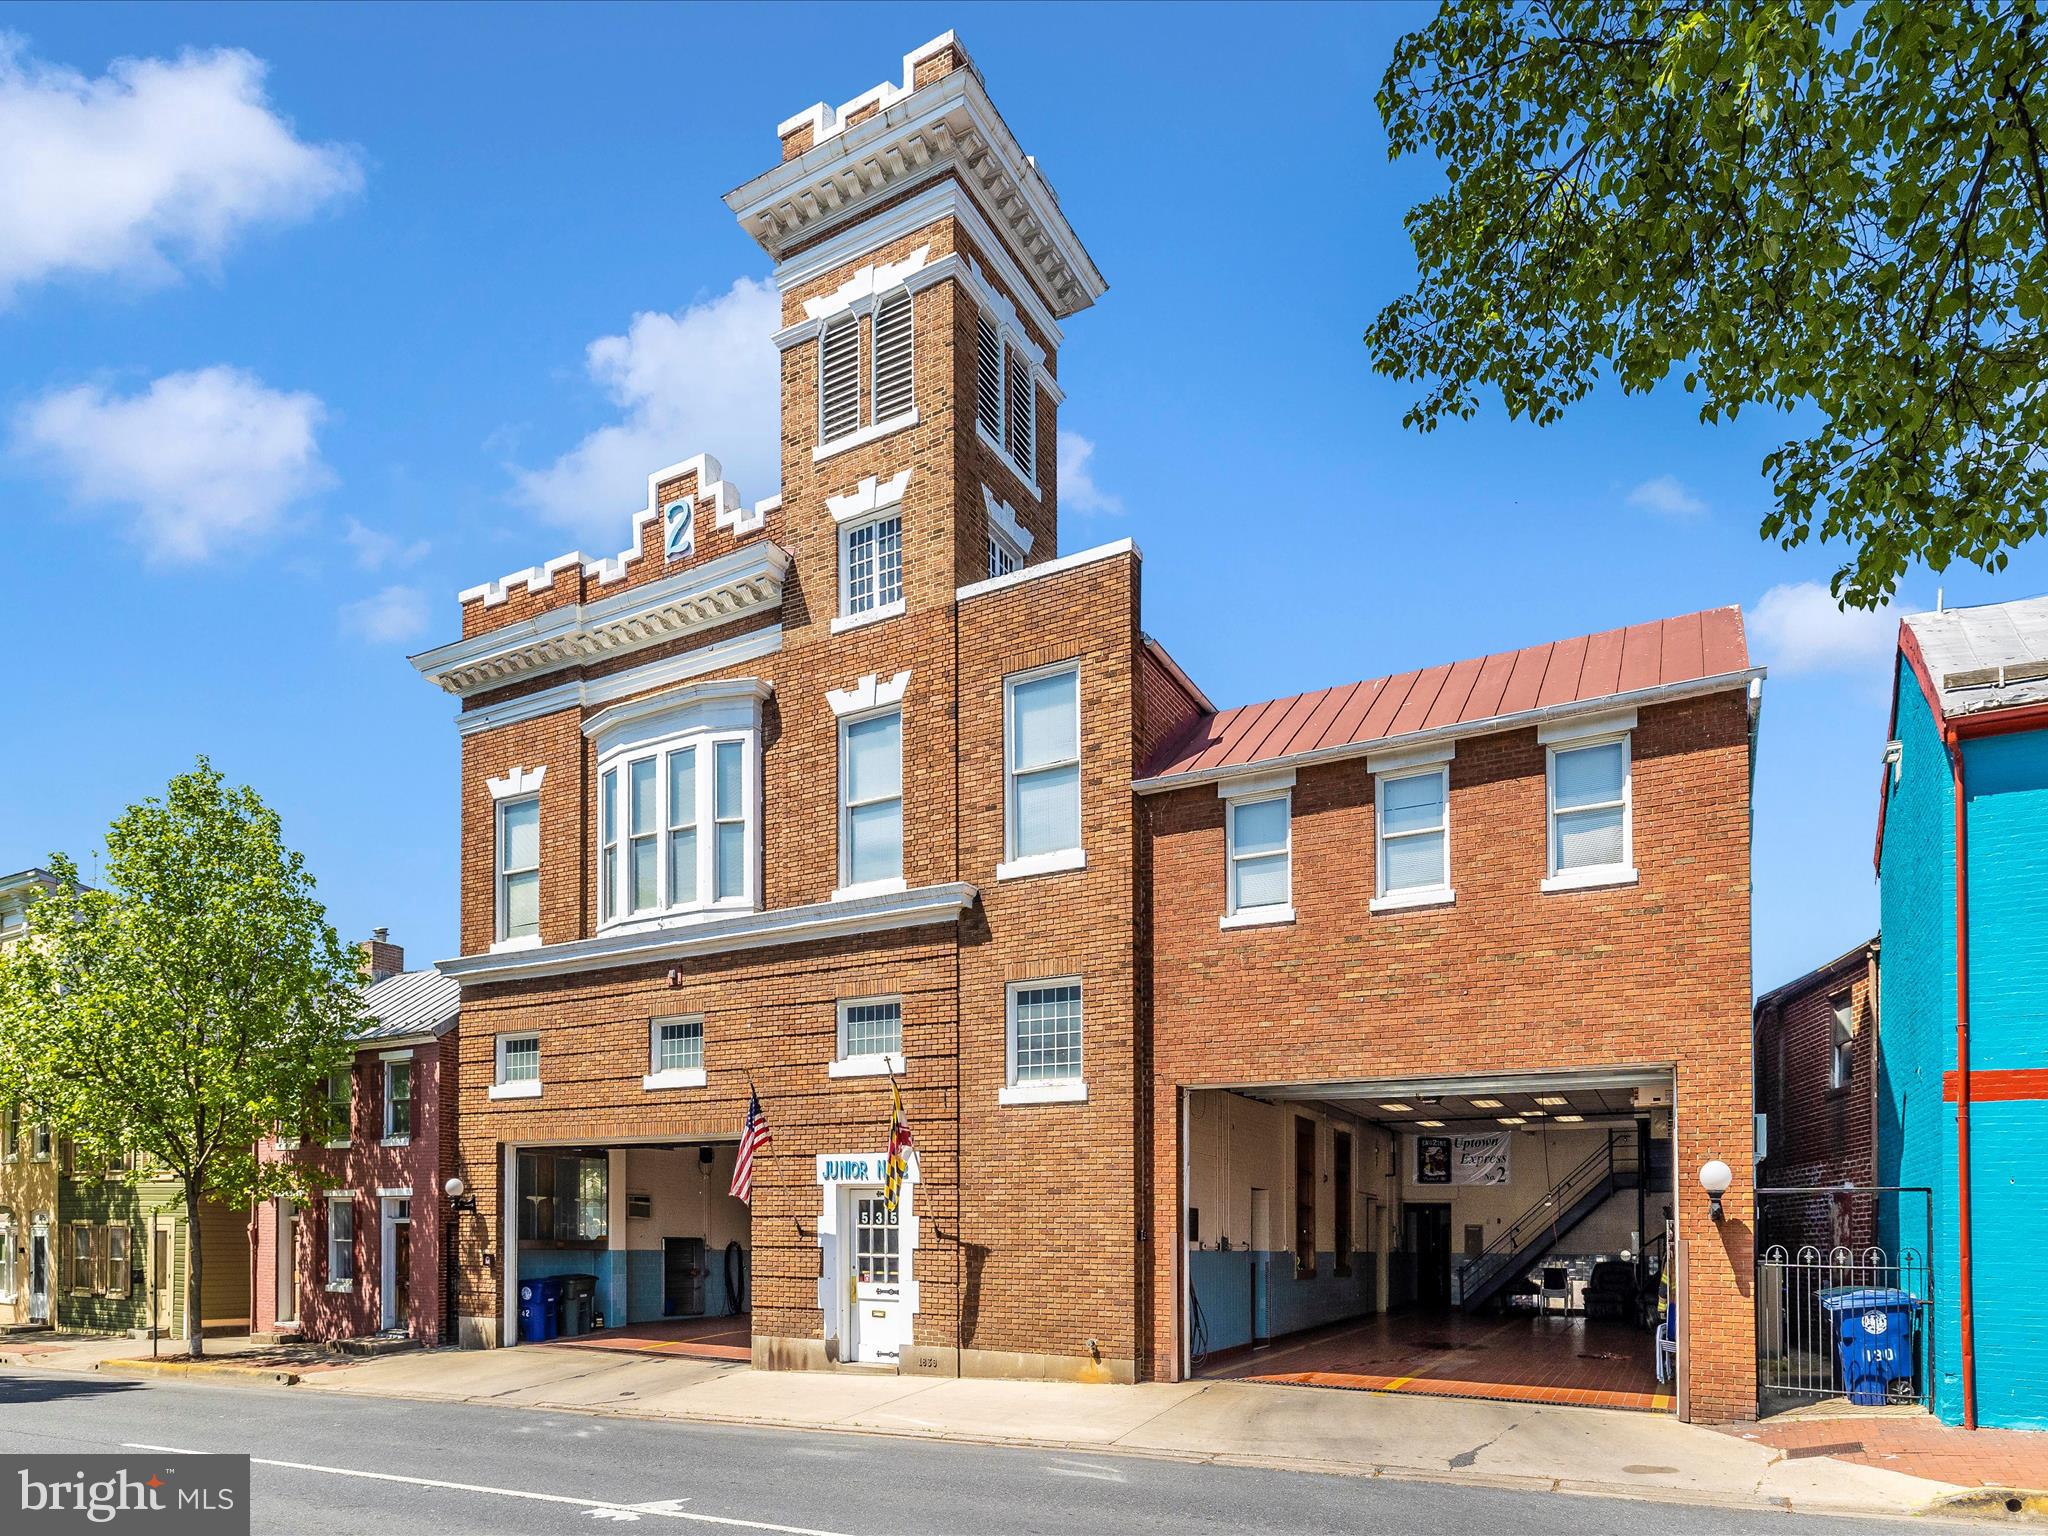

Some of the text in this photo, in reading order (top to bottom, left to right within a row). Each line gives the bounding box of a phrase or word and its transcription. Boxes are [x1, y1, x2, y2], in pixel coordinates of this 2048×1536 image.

[665, 499, 693, 561] 2
[1454, 1138, 1499, 1150] Uptown
[1460, 1153, 1507, 1167] Express
[822, 1160, 869, 1181] JUNIOR
[1497, 1166, 1507, 1182] 2
